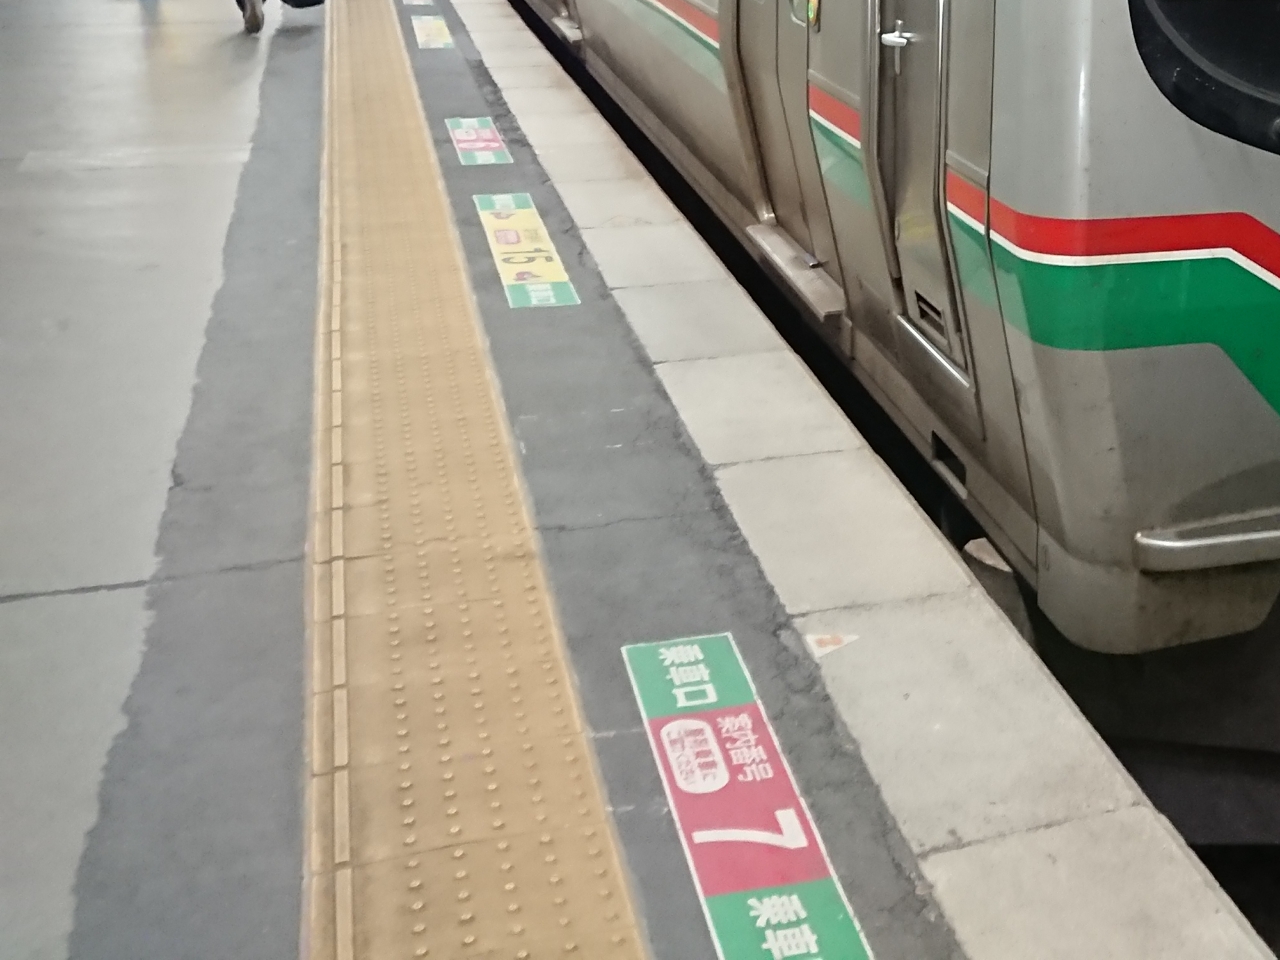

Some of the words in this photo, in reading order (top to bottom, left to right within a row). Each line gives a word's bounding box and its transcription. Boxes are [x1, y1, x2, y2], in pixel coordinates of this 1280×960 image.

[658, 643, 719, 708] 乗車口
[716, 712, 774, 782] 案内番号
[691, 807, 809, 850] 7
[747, 894, 823, 960] 乗車
